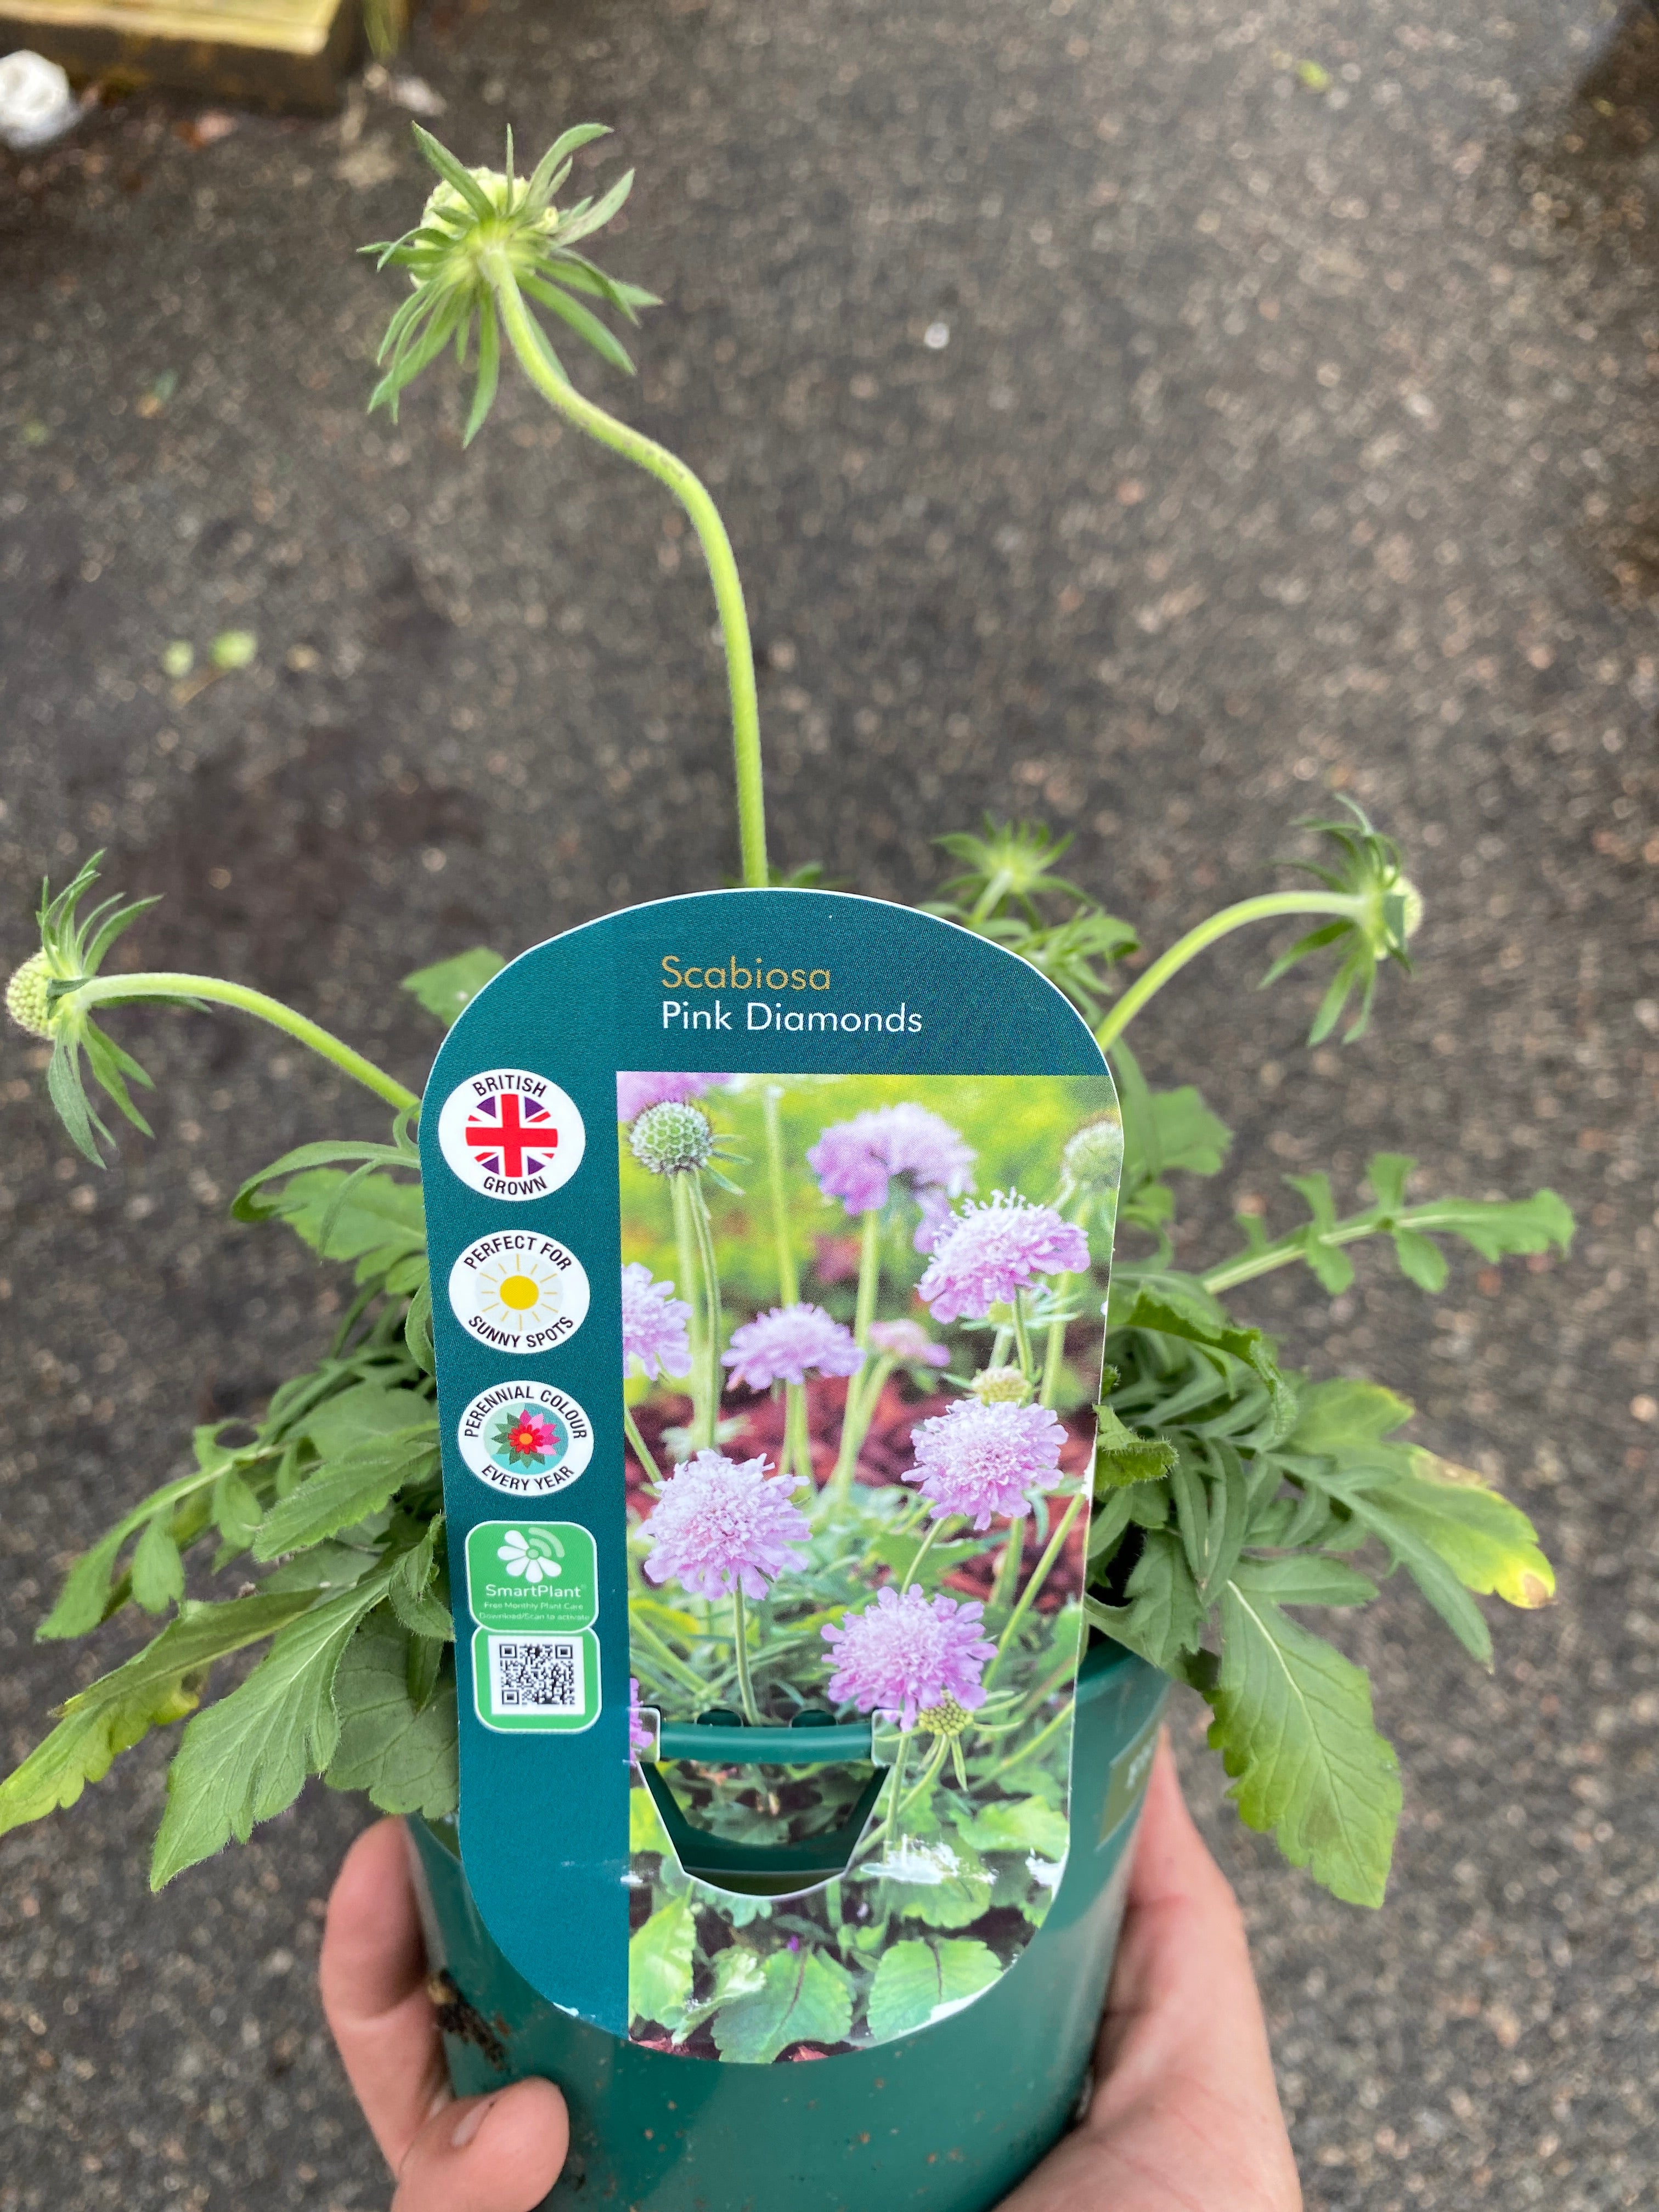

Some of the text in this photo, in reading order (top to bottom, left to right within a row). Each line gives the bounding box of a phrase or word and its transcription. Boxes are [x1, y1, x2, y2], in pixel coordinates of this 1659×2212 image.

[661, 955, 831, 991] Scabiosa
[662, 1000, 923, 1033] Pink Diamonds
[472, 1074, 548, 1098] BRITISH
[483, 1176, 548, 1195] GROWN
[464, 1235, 572, 1271] PERFECT FOR
[469, 1315, 574, 1348] SUNNY SPOTS
[464, 1385, 588, 1439] PERENNIAL COLOUR
[481, 1464, 575, 1491] EVERY YEAR
[504, 1601, 539, 1610] Monthly
[540, 1601, 562, 1610] Plant
